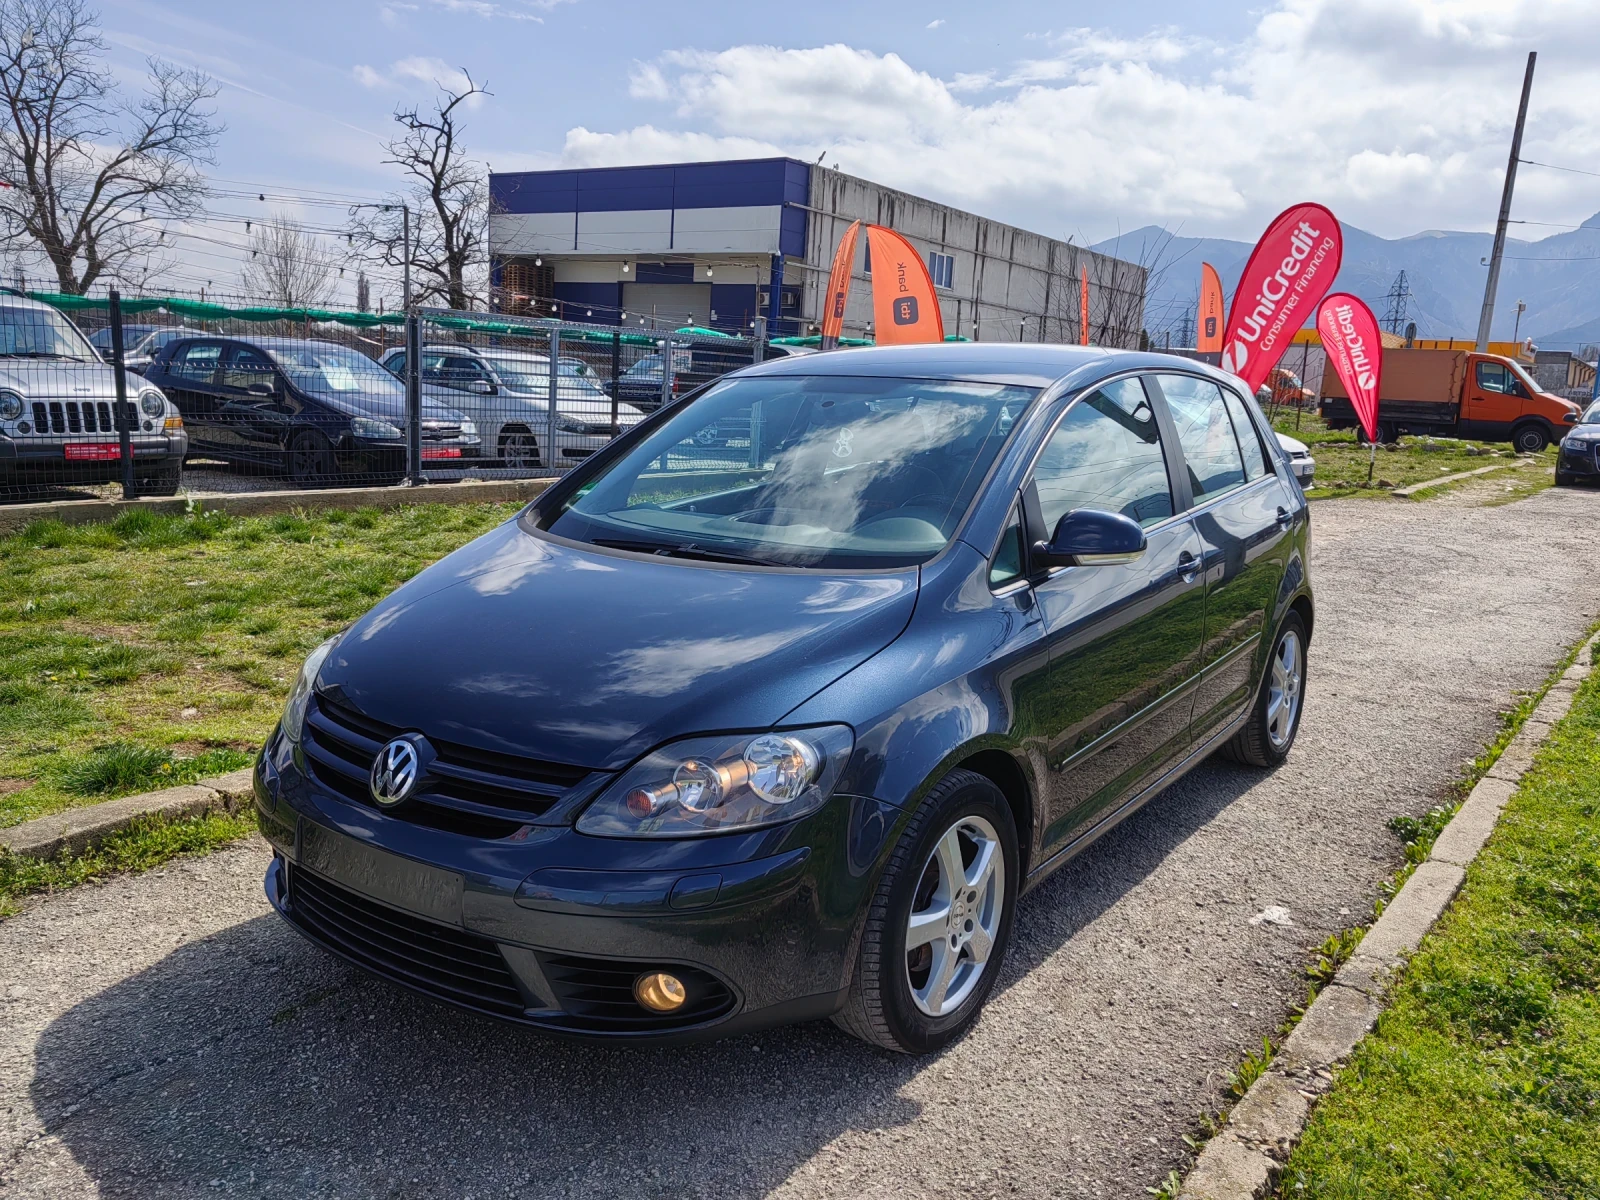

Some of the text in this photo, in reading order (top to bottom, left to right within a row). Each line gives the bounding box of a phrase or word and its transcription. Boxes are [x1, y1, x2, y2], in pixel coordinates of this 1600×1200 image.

[1237, 221, 1320, 342] UniCredit
[1260, 236, 1335, 351] Consumer Financing
